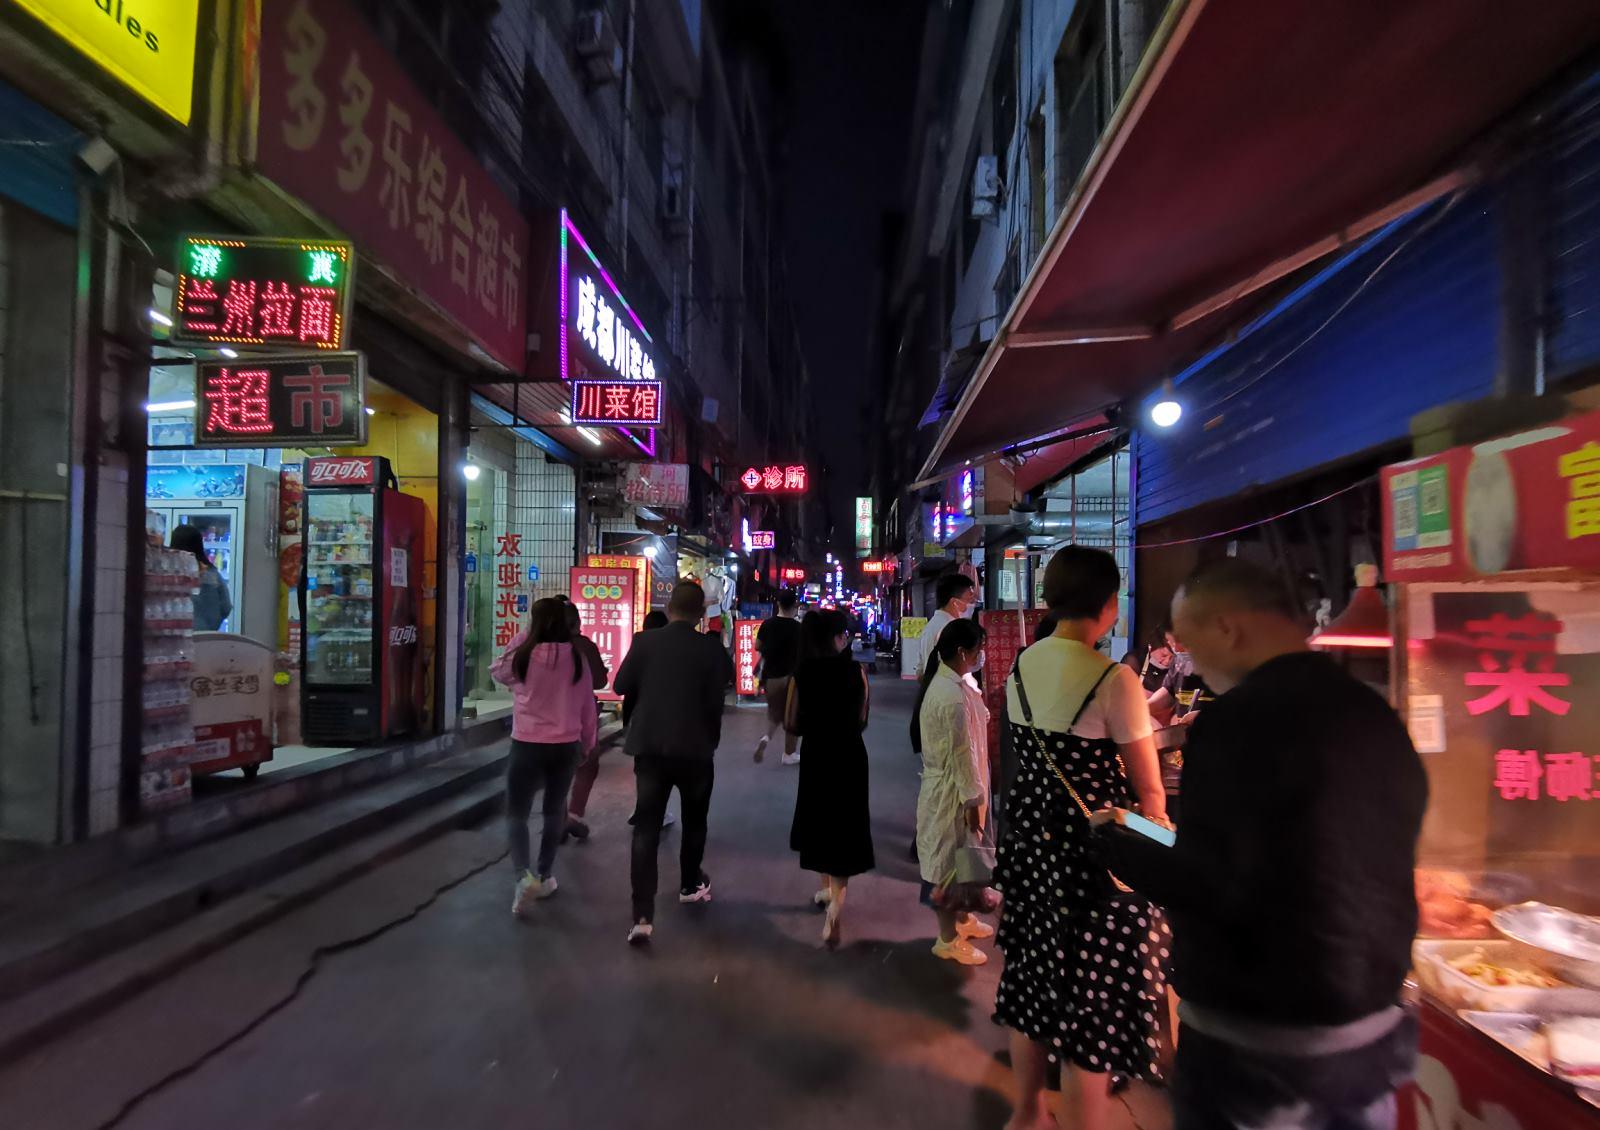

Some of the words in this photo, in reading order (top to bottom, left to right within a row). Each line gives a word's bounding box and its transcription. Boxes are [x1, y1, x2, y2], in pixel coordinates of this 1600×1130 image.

[281, 0, 521, 332] 多多乐综合超市
[186, 280, 336, 341] 兰州拉面
[205, 364, 351, 434] 超市
[578, 385, 657, 419] 川菜馆
[310, 459, 373, 482] 可口可乐
[763, 465, 806, 490] 诊所
[752, 534, 772, 546] 纹身
[739, 624, 753, 691] 串串麻辣烫
